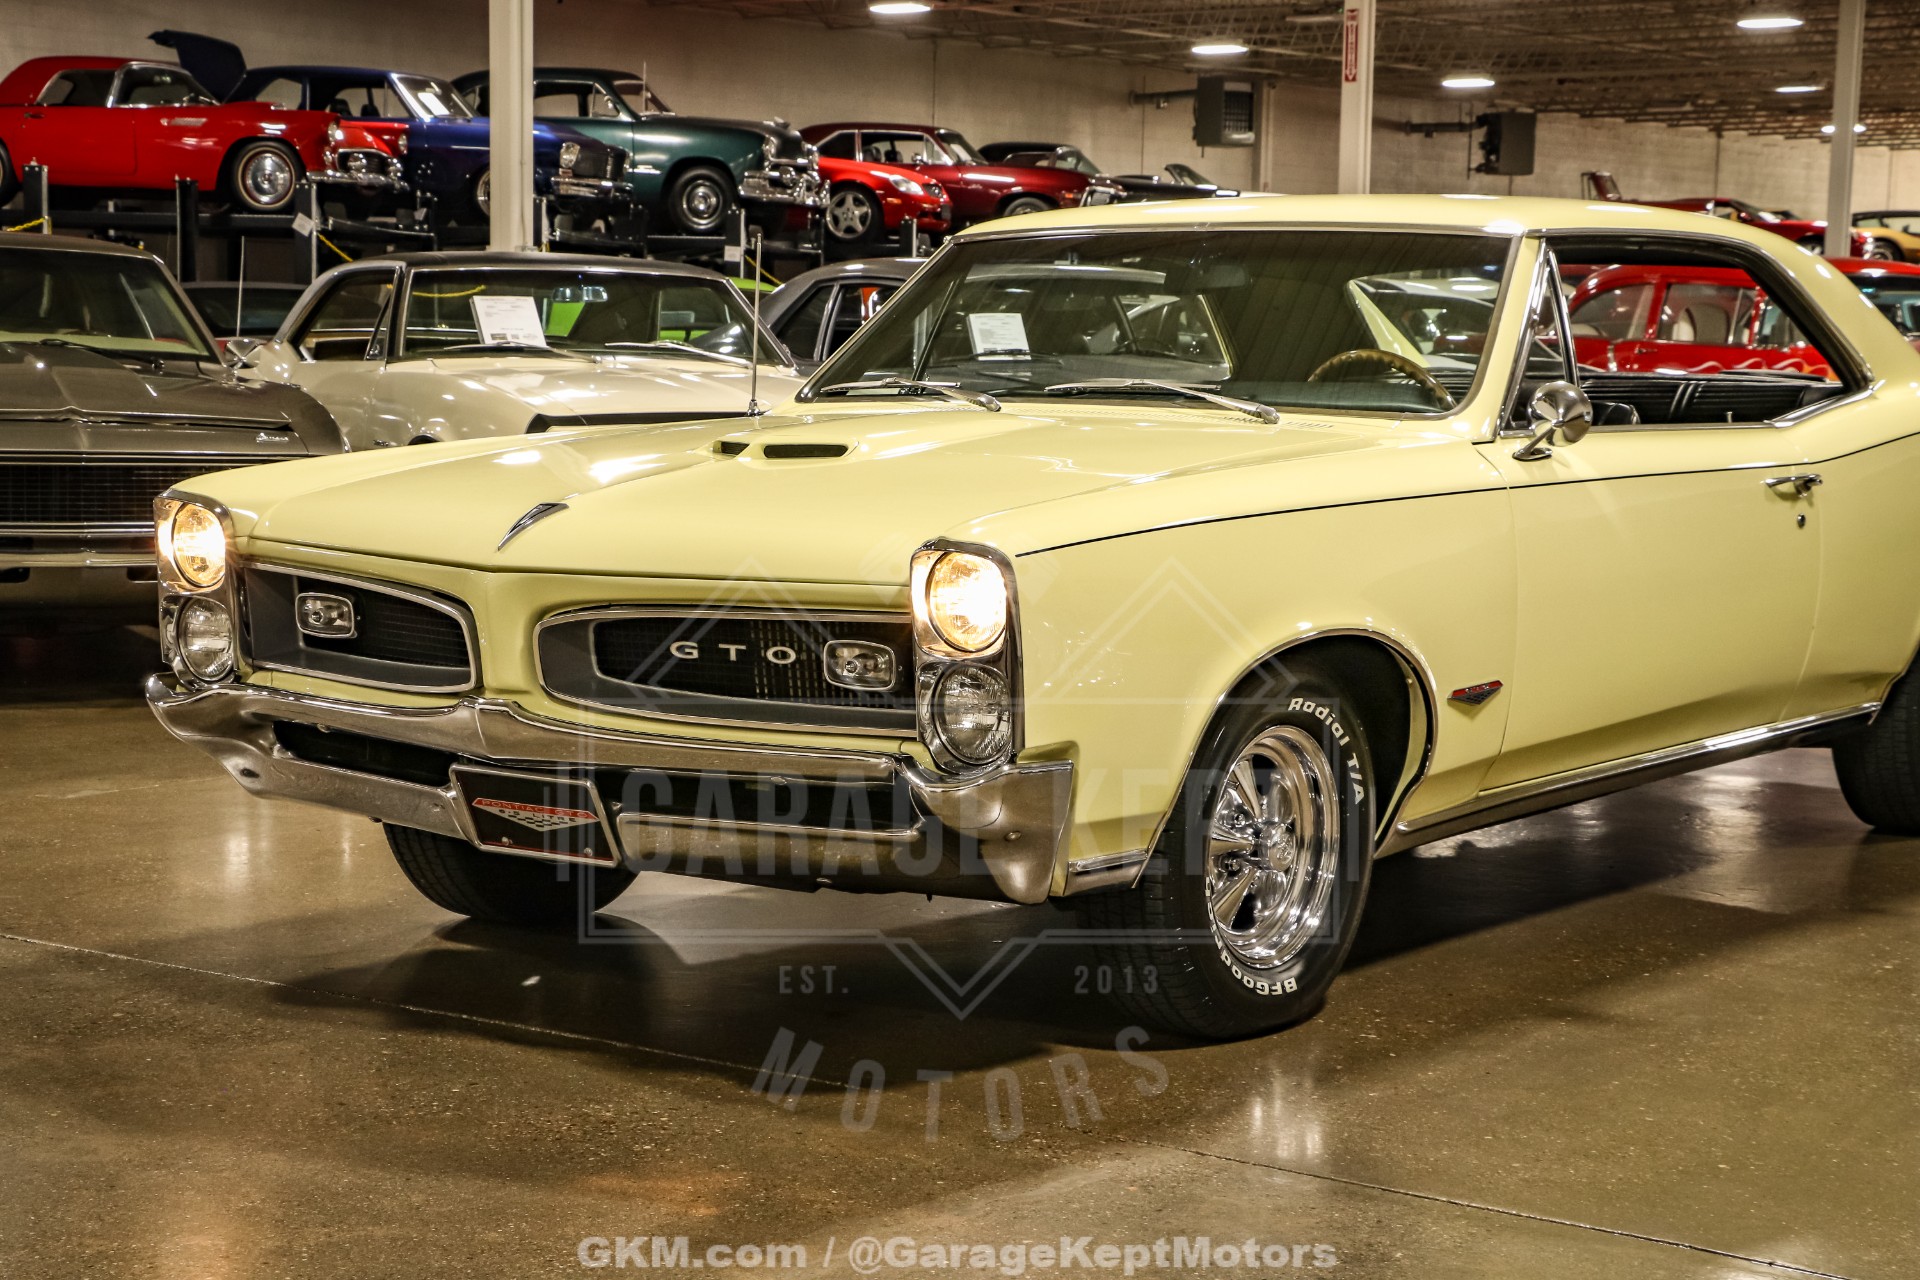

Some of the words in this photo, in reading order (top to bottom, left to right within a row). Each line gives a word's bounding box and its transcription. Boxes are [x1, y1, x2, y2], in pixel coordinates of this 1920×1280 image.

[669, 640, 797, 665] GTO
[1287, 697, 1351, 747] Radial
[1346, 752, 1365, 805] T/A
[482, 800, 544, 813] PONTIAC
[554, 809, 588, 818] GTO
[532, 813, 577, 822] LITRE
[1204, 876, 1298, 996] BFGoodrich
